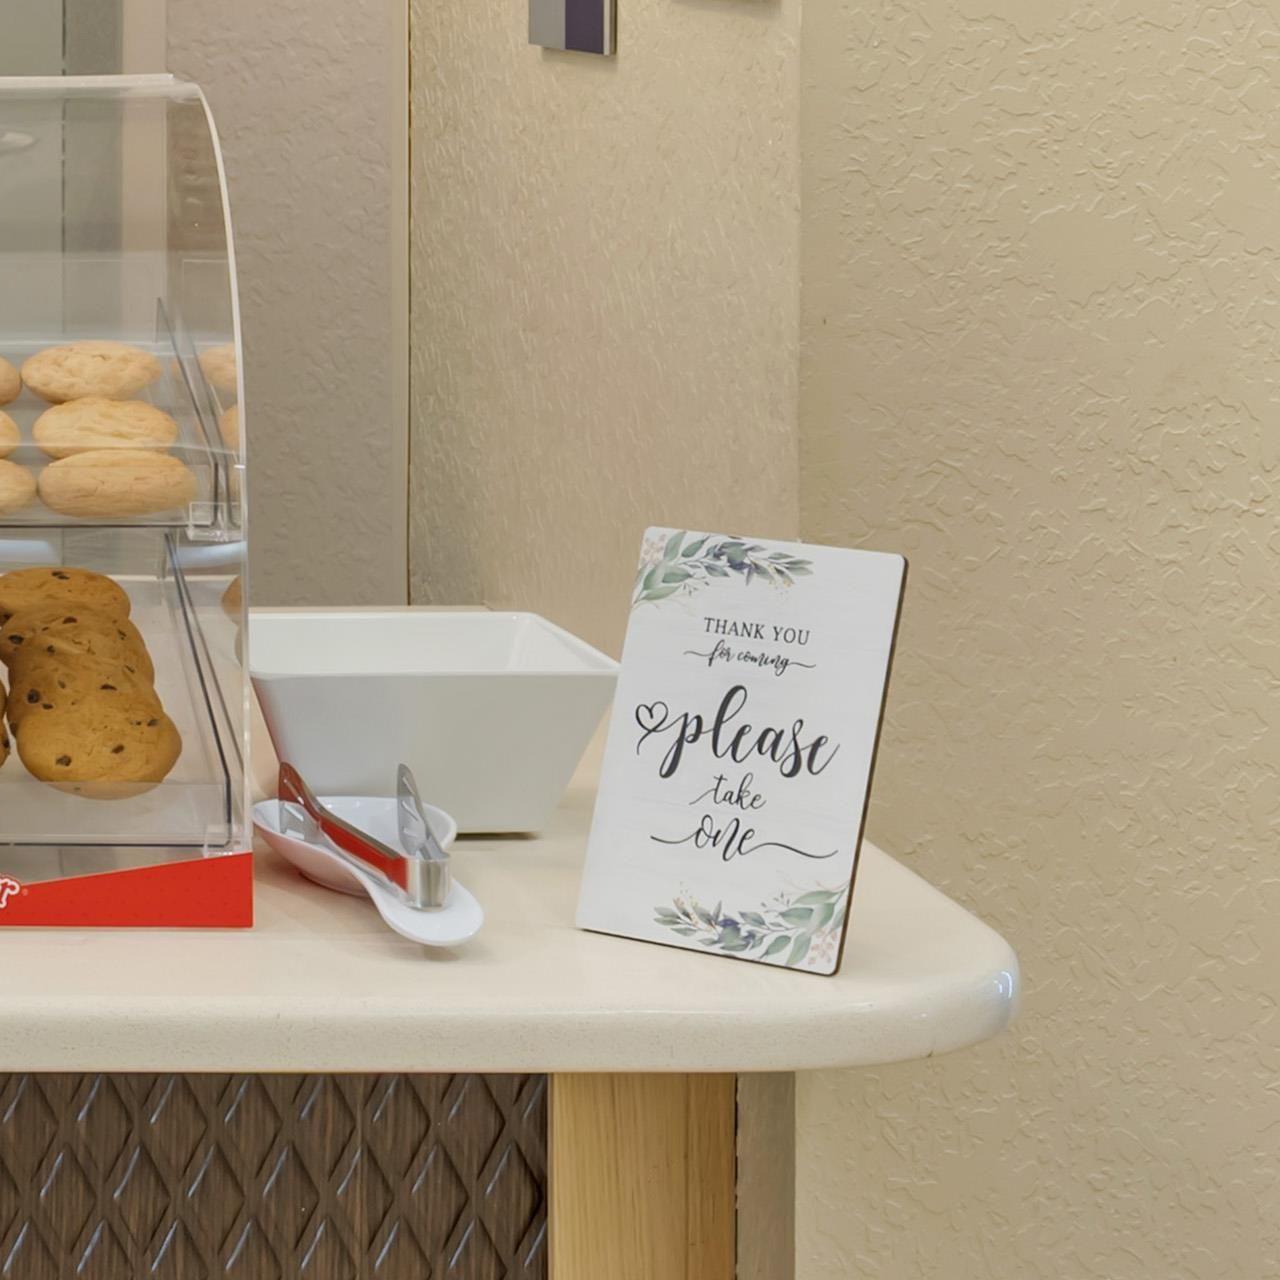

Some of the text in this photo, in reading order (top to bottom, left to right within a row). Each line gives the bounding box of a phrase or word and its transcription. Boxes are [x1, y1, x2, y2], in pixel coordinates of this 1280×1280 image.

[704, 616, 811, 646] THANK YOU
[652, 684, 841, 779] please
[688, 772, 767, 810] take
